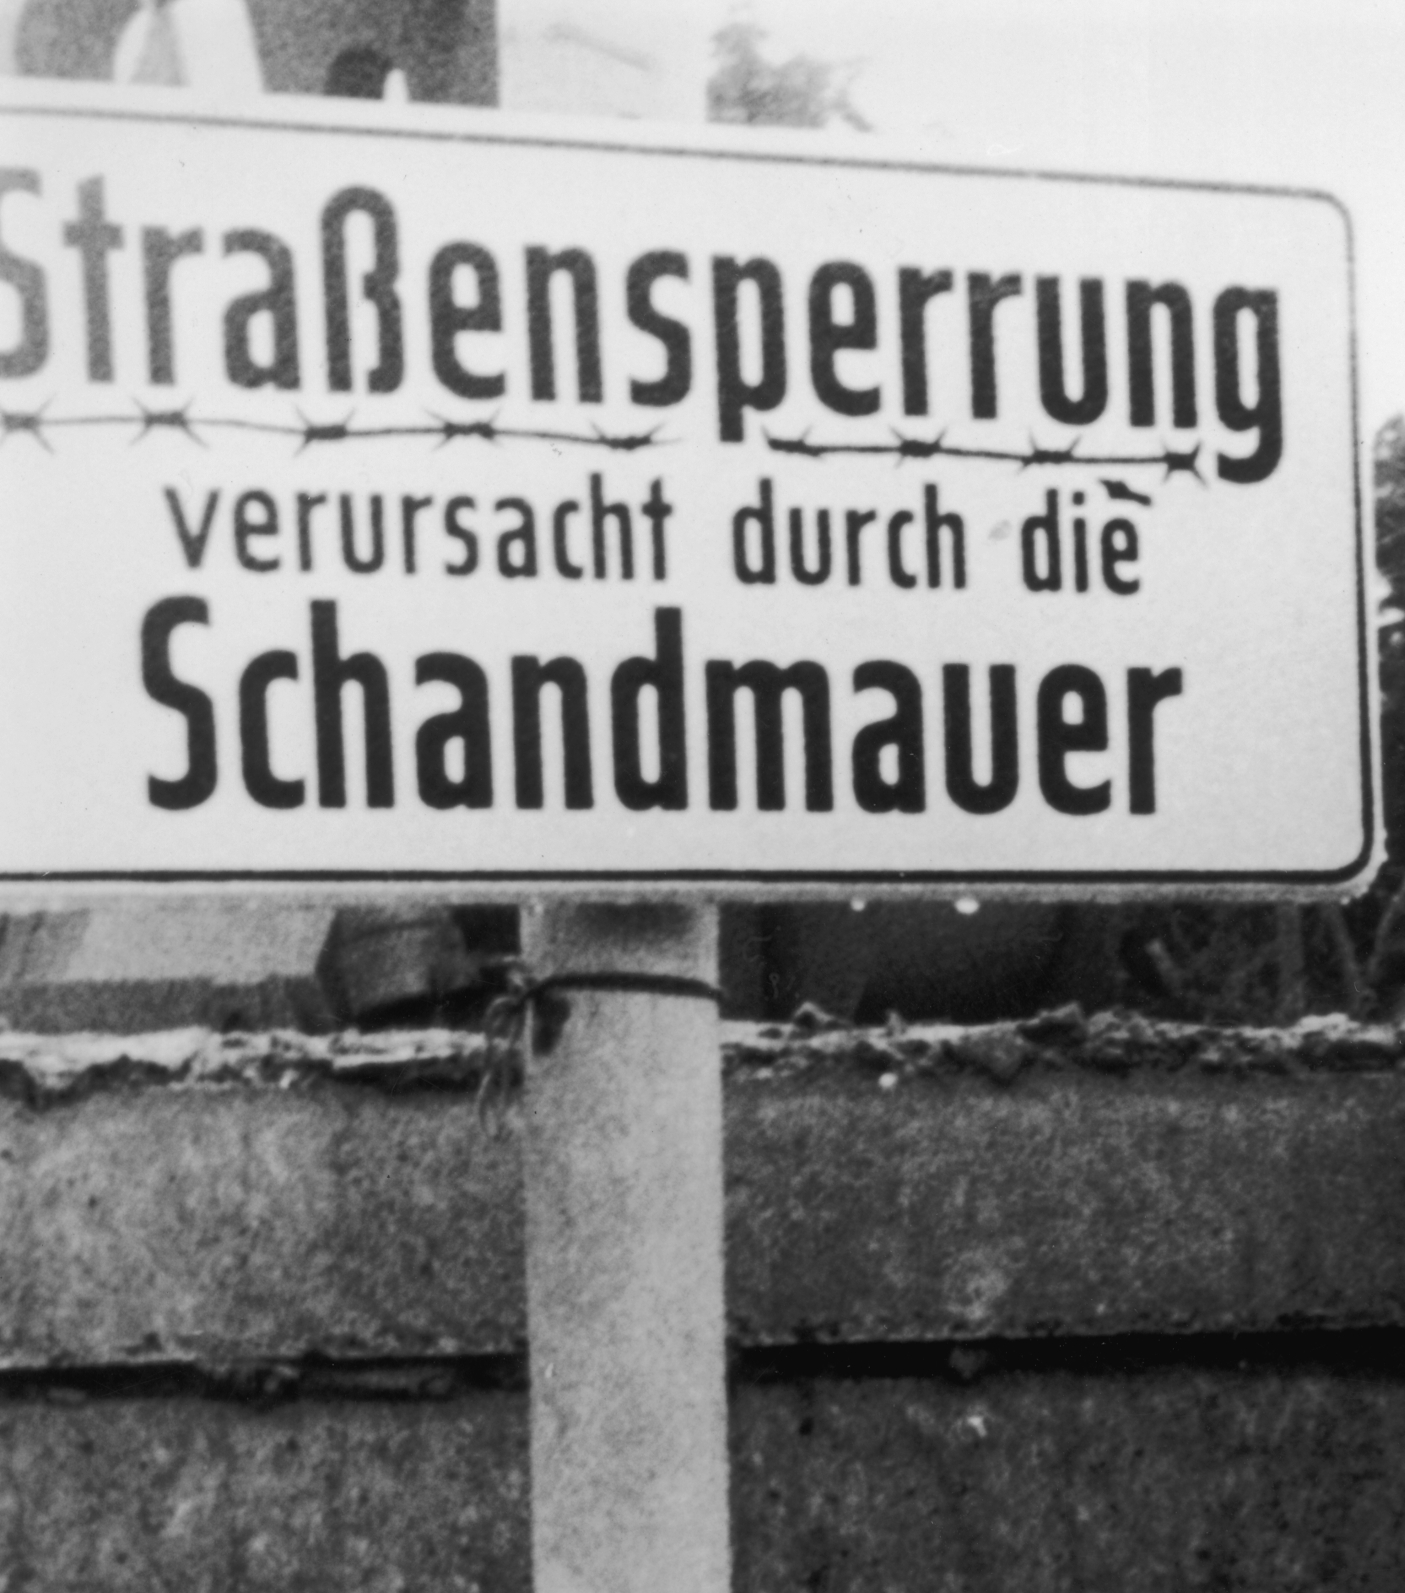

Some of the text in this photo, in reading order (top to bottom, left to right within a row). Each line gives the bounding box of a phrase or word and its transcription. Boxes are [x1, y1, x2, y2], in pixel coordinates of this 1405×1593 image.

[0, 168, 1285, 485] Straßensperrung
[163, 472, 1143, 596] verursacht durch die
[139, 595, 1184, 816] Schandmauer
